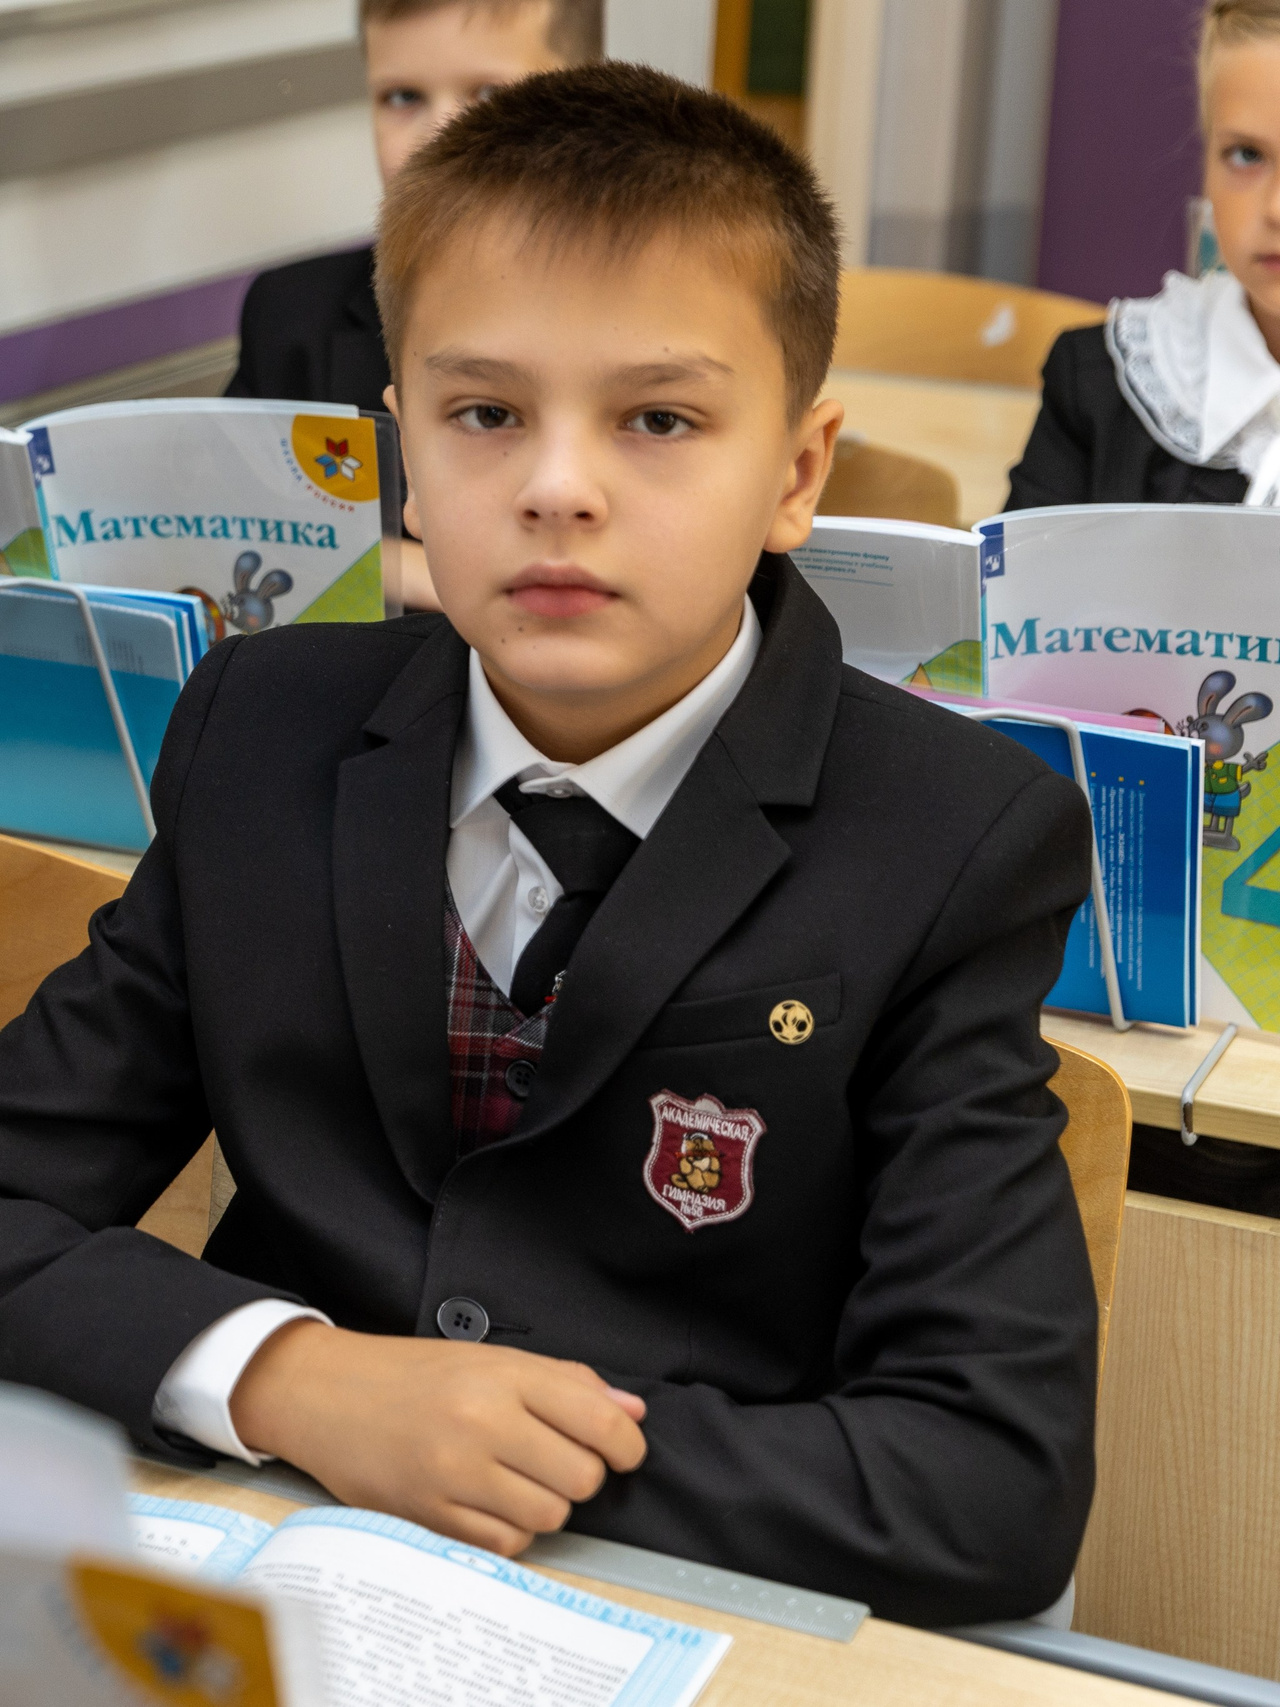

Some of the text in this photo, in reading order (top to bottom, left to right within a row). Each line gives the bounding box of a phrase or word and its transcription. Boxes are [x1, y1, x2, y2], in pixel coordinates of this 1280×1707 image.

[52, 508, 339, 550] Математика
[660, 1105, 751, 1141] АКАДЕМИЧЕСКАЯ
[661, 1184, 727, 1212] ГИМНАЗИЯ
